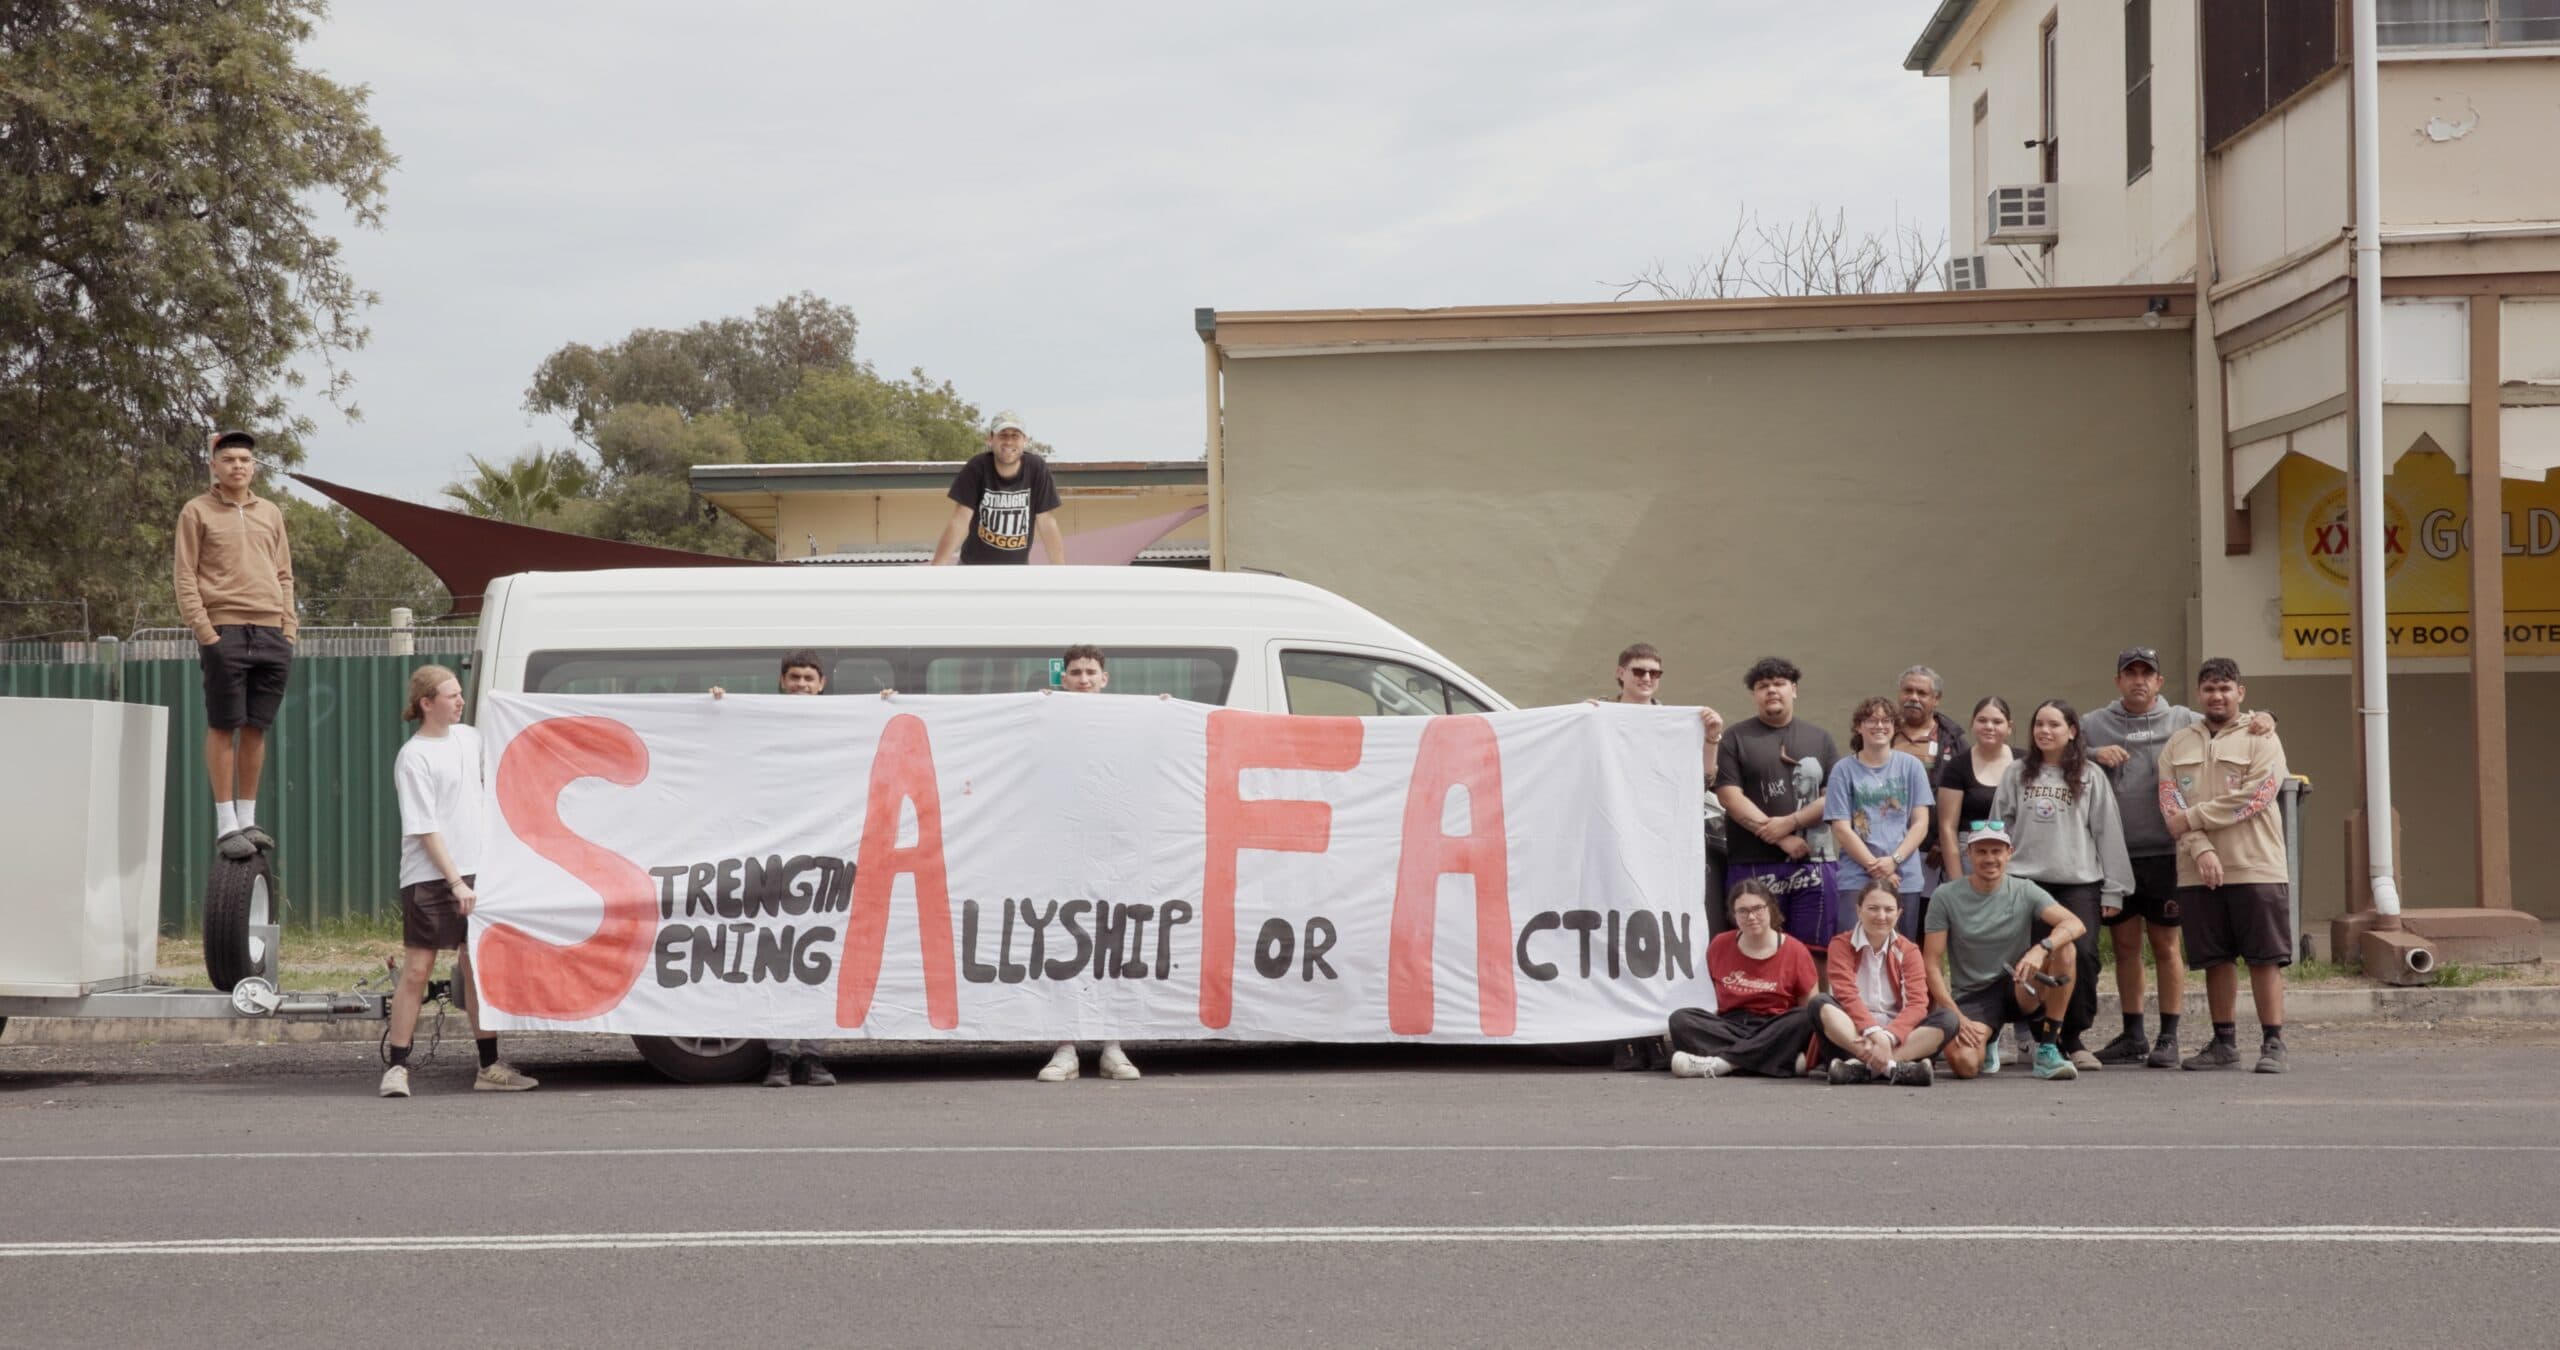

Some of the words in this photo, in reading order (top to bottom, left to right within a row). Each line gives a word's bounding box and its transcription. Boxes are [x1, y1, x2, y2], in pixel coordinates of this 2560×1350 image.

[980, 507, 1027, 535] OUTTA
[2420, 507, 2560, 561] GLD
[2023, 785, 2073, 806] STEELERS
